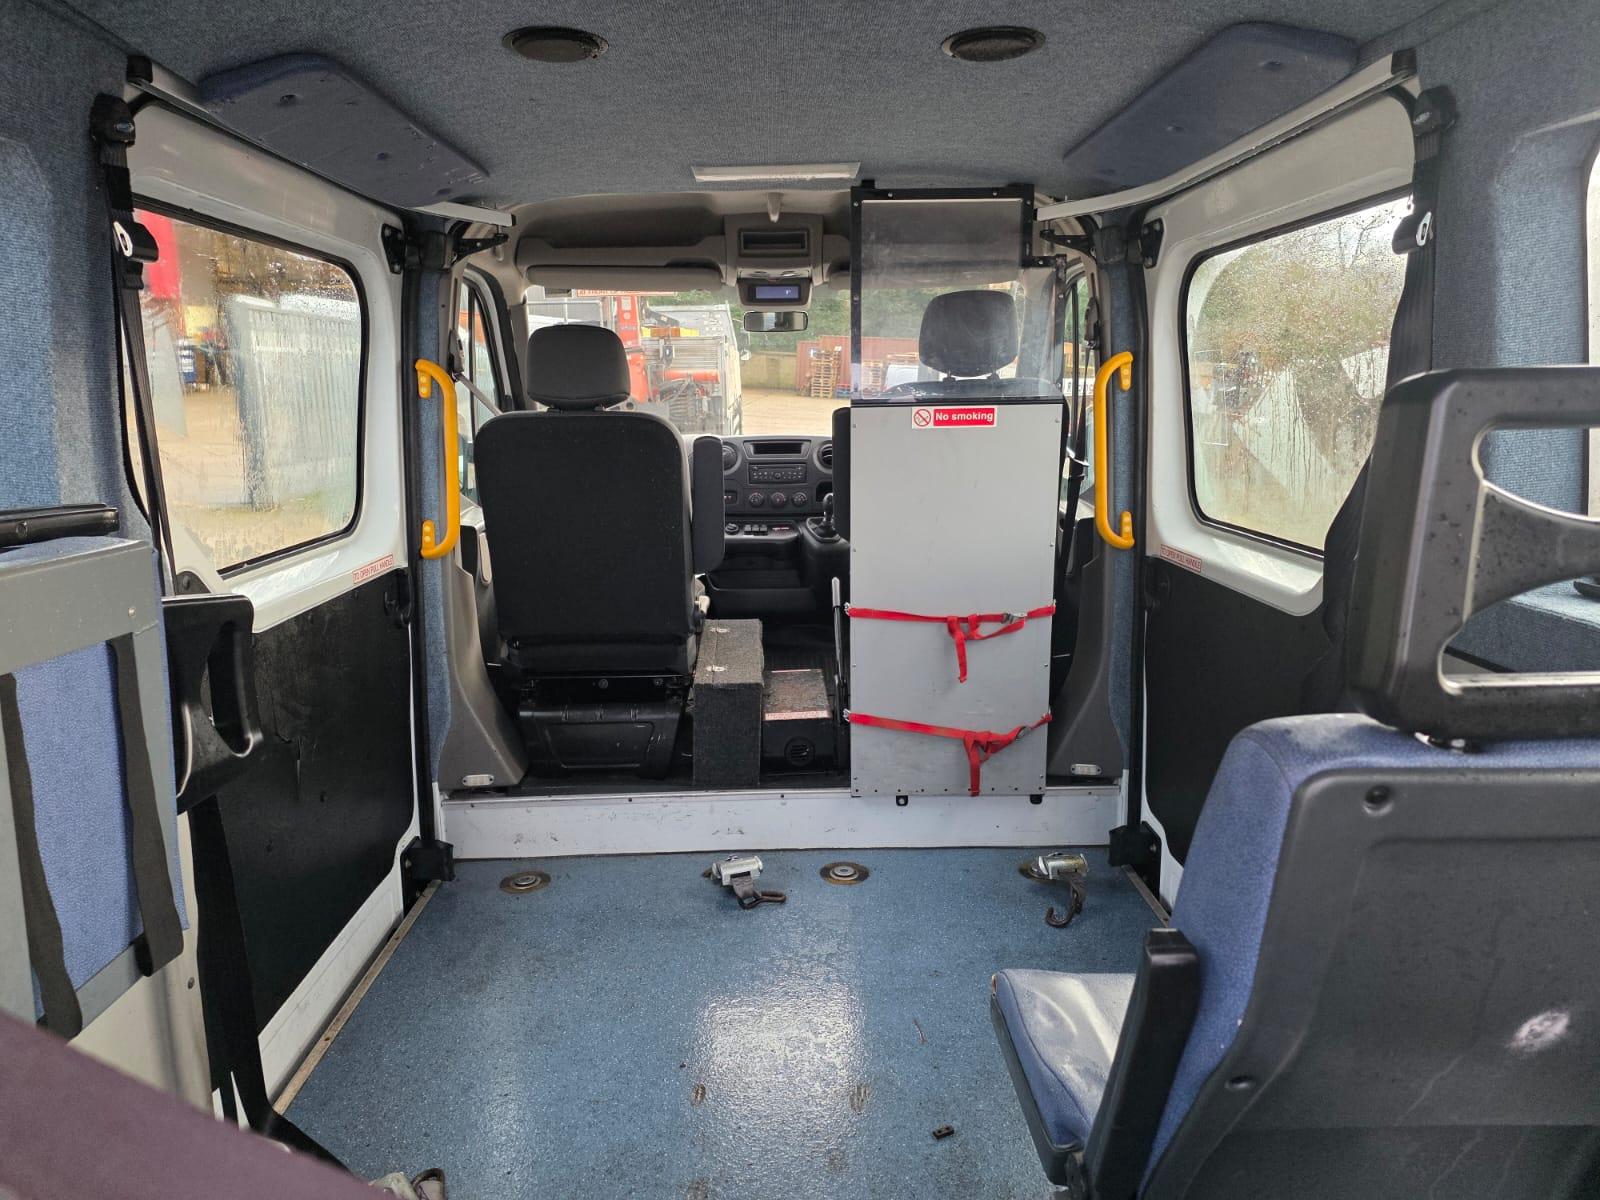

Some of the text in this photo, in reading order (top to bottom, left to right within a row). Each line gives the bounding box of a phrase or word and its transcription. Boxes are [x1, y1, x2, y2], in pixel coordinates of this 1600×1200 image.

[935, 411, 993, 422] No smoking
[359, 569, 370, 578] OPEN
[370, 564, 380, 574] PULL
[380, 557, 393, 569] HANDLE
[1175, 553, 1185, 563] PULL
[1185, 557, 1201, 569] HANDLE
